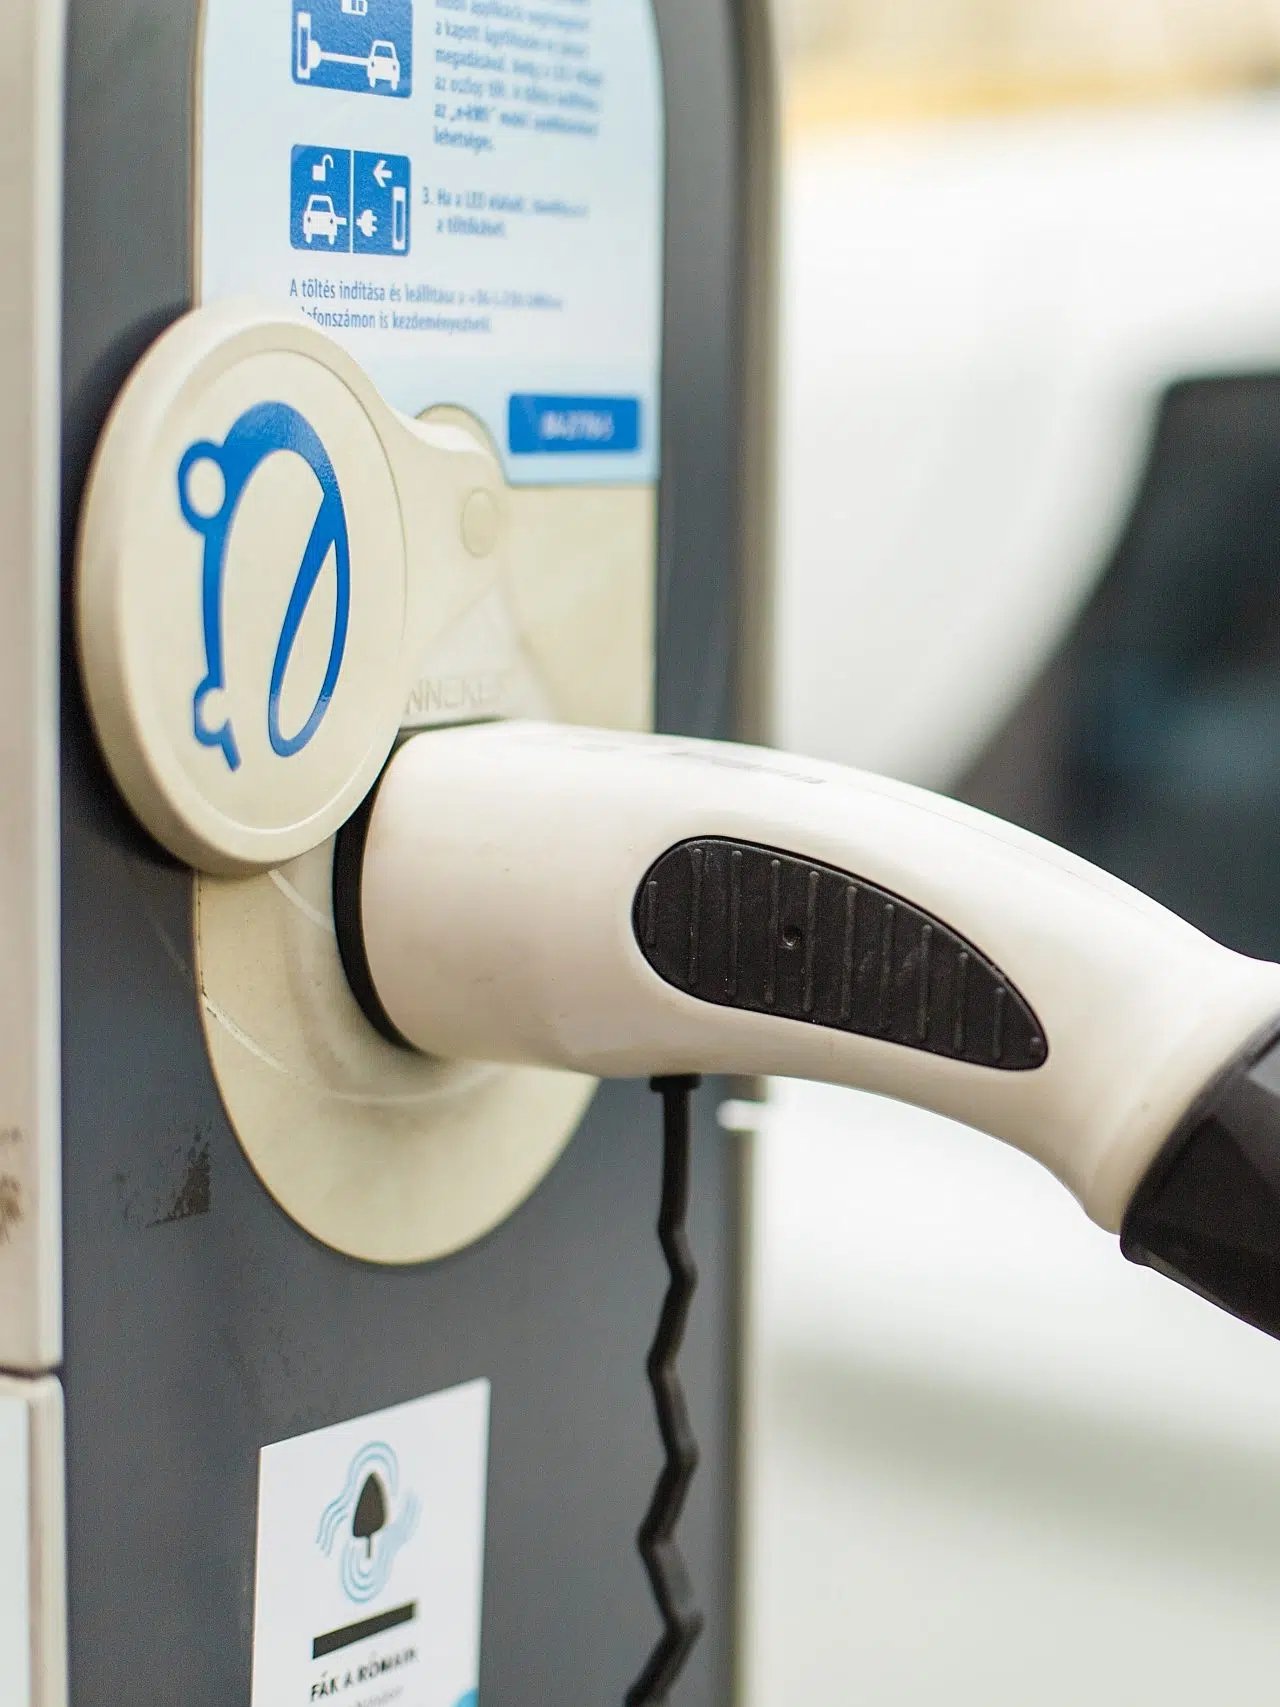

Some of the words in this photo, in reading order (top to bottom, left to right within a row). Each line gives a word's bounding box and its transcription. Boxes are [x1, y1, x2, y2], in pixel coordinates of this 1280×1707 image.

[422, 185, 433, 205] 3.
[289, 278, 298, 298] A
[302, 278, 336, 300] töltés
[340, 280, 386, 302] indítása
[389, 283, 402, 302] és
[302, 306, 377, 329] fonszámon
[379, 309, 389, 329] is
[310, 1670, 339, 1702] FÁK
[343, 1670, 353, 1689] A
